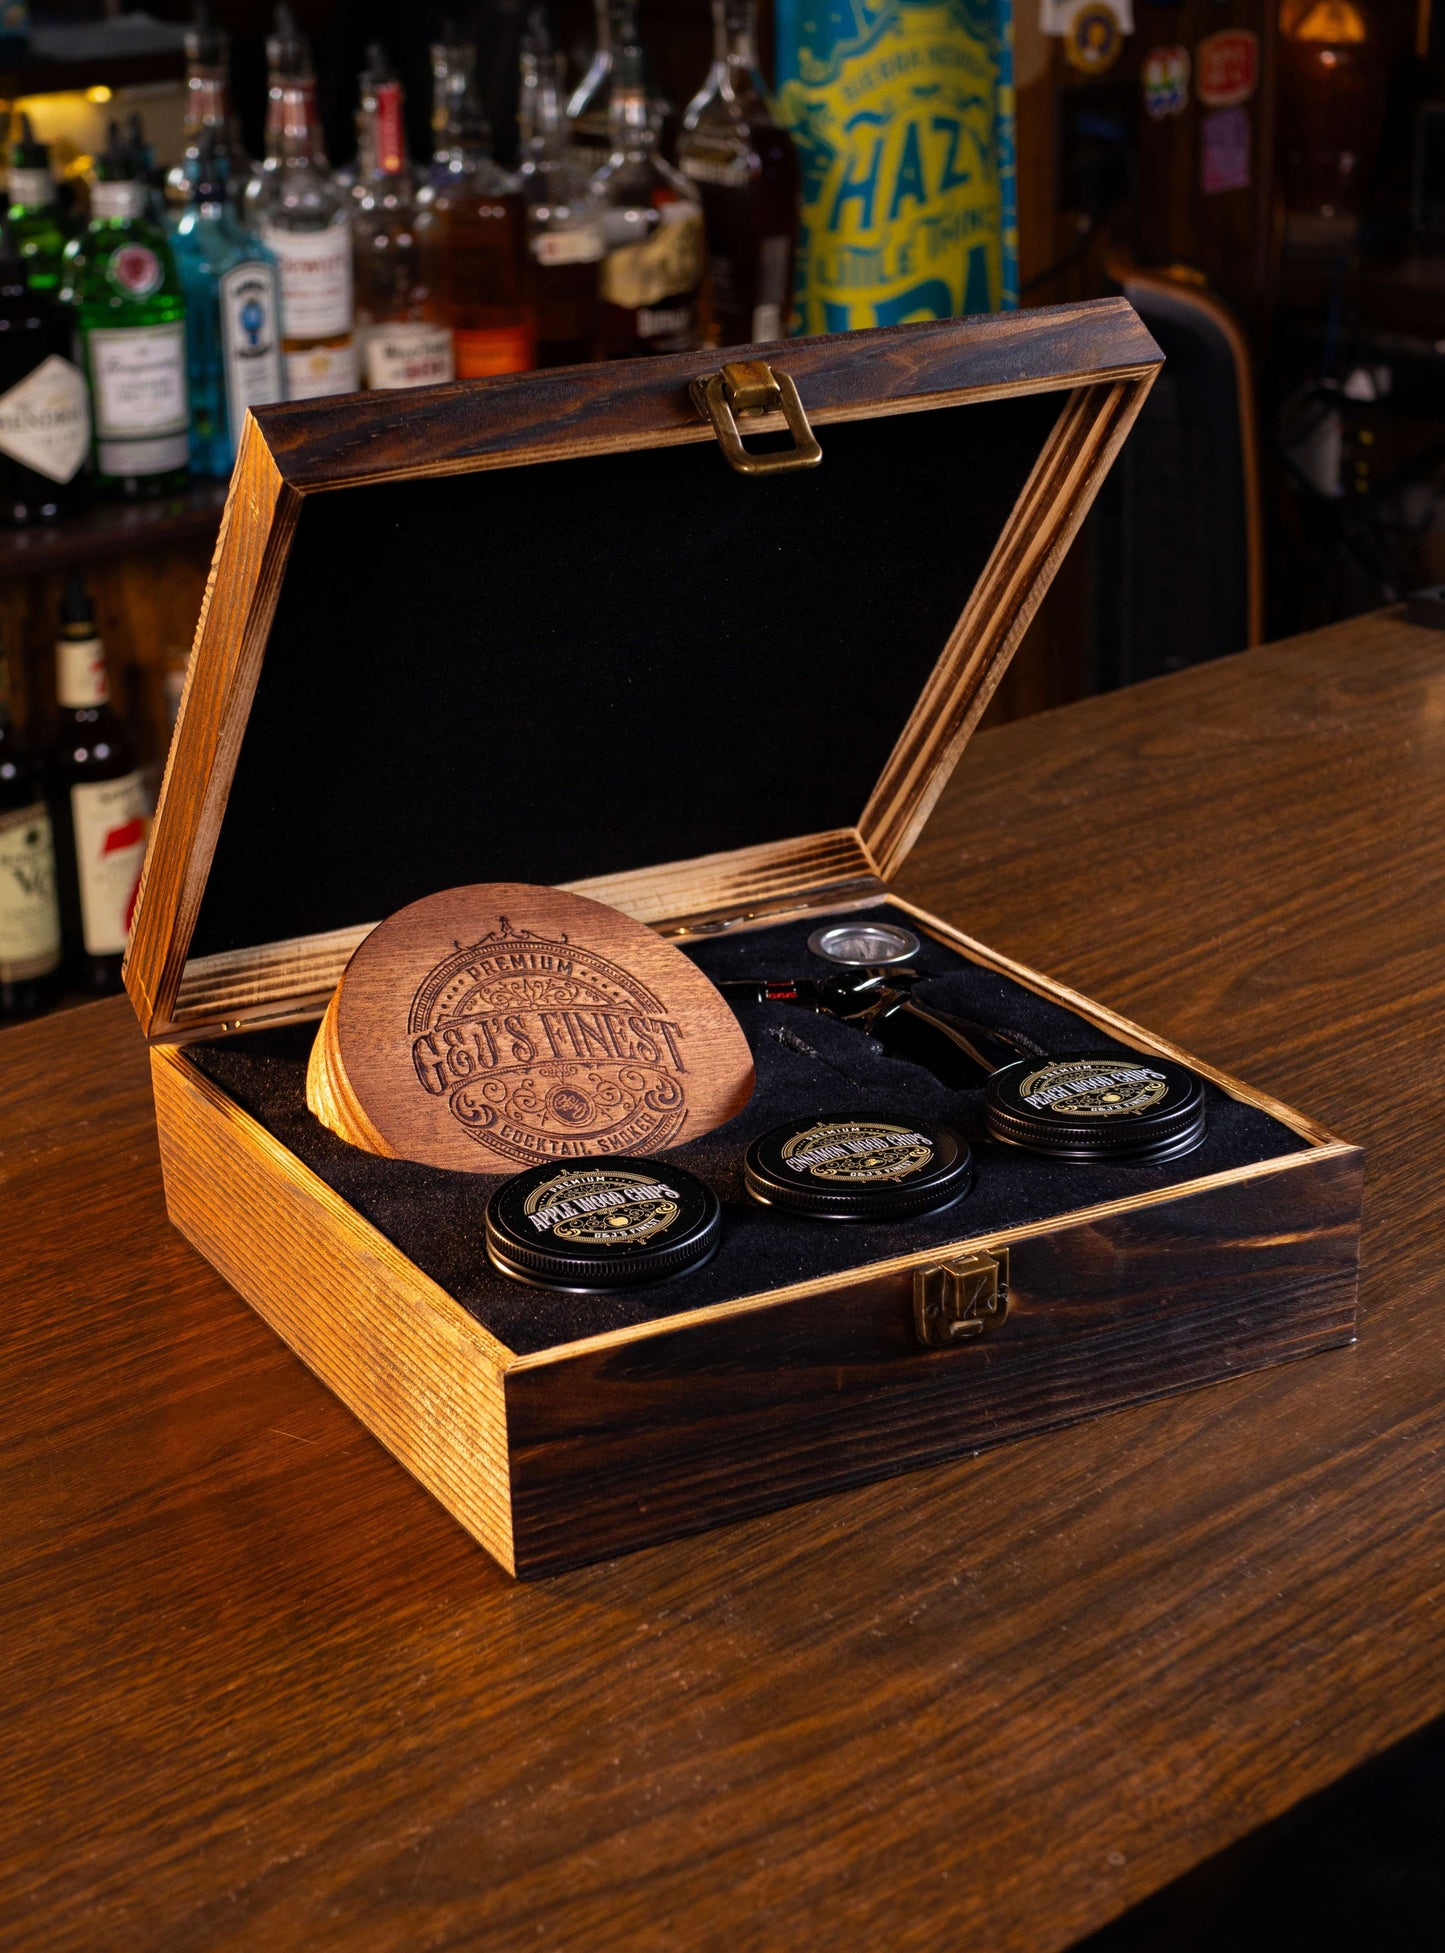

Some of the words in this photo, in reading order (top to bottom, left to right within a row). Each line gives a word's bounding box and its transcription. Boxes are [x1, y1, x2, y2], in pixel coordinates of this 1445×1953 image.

[466, 954, 574, 982] PREMIUM
[537, 1011, 687, 1074] FINEST
[1040, 1064, 1092, 1080] PREMIUM
[1024, 1085, 1072, 1110] PEACH
[1066, 1075, 1114, 1093] WOOD
[1110, 1068, 1167, 1083] CHIPS
[1124, 1094, 1152, 1107] FINEST
[500, 1124, 591, 1156] COCKTAIL
[597, 1112, 656, 1152] SMOKER
[805, 1127, 860, 1141] PREMIUM
[785, 1144, 848, 1173] CINNAMON
[844, 1137, 890, 1153] WOOD
[886, 1132, 933, 1146] CHIPS
[884, 1160, 916, 1173] FINEST
[549, 1176, 605, 1192] PREMIUM
[528, 1202, 579, 1232] APPLE
[572, 1190, 627, 1212] WOOD
[624, 1183, 681, 1201] CHIPS
[594, 1230, 627, 1239] G&J'S
[629, 1218, 661, 1236] FINEST
